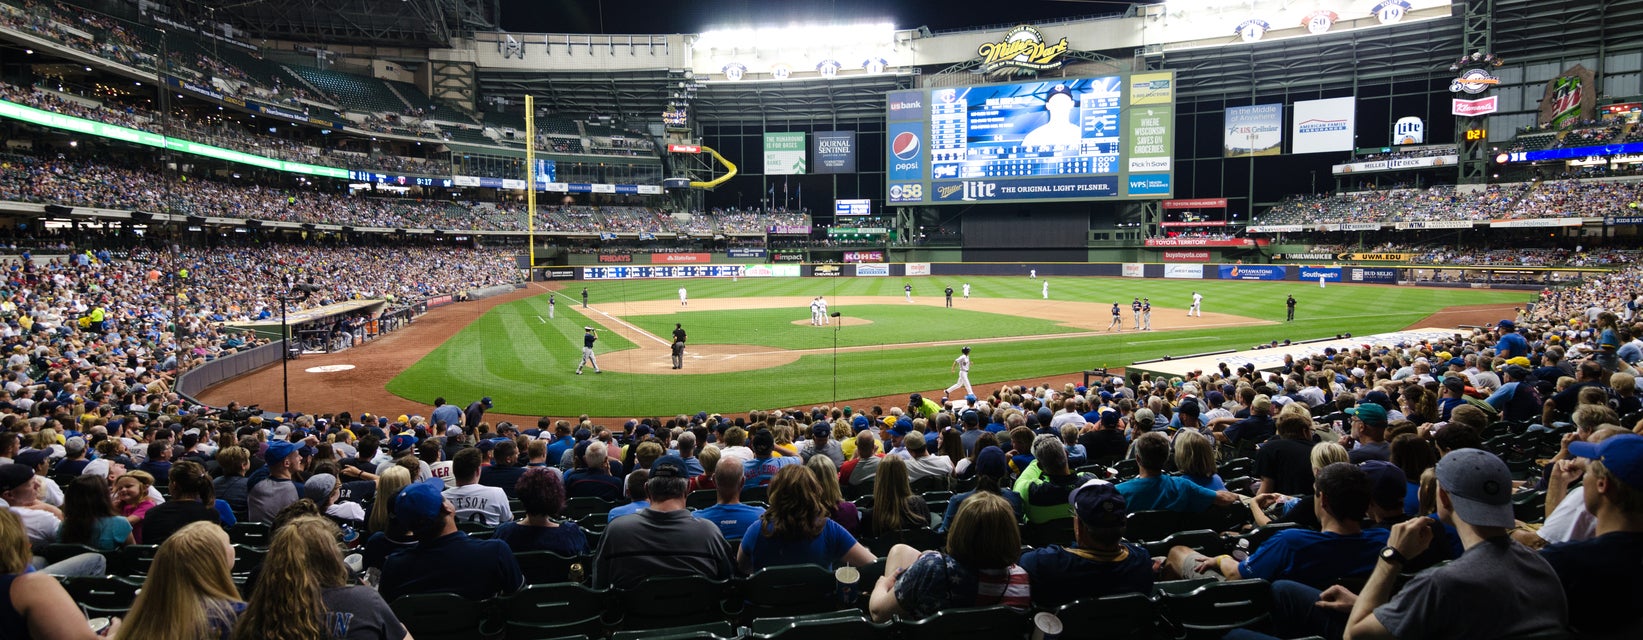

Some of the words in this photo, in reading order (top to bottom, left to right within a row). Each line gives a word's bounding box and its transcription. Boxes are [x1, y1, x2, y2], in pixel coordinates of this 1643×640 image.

[1384, 8, 1399, 20] 19
[1313, 18, 1326, 26] 50
[1247, 29, 1254, 38] 4
[978, 39, 1033, 64] Miller
[1023, 36, 1069, 63] Park
[1141, 118, 1160, 127] WHERE
[1135, 126, 1166, 136] WISCONSIN
[1398, 122, 1420, 135] Lite
[818, 146, 850, 154] SENTINEL
[896, 162, 918, 171] pepsi
[1364, 161, 1386, 169] MILLER
[1386, 159, 1402, 170] Lite
[902, 184, 922, 199] 58
[937, 184, 963, 199] Miller
[962, 181, 996, 201] Lite
[1017, 185, 1052, 194] ORIGINAL
[1053, 184, 1076, 192] LIGHT
[599, 254, 631, 262] FRIDAYS
